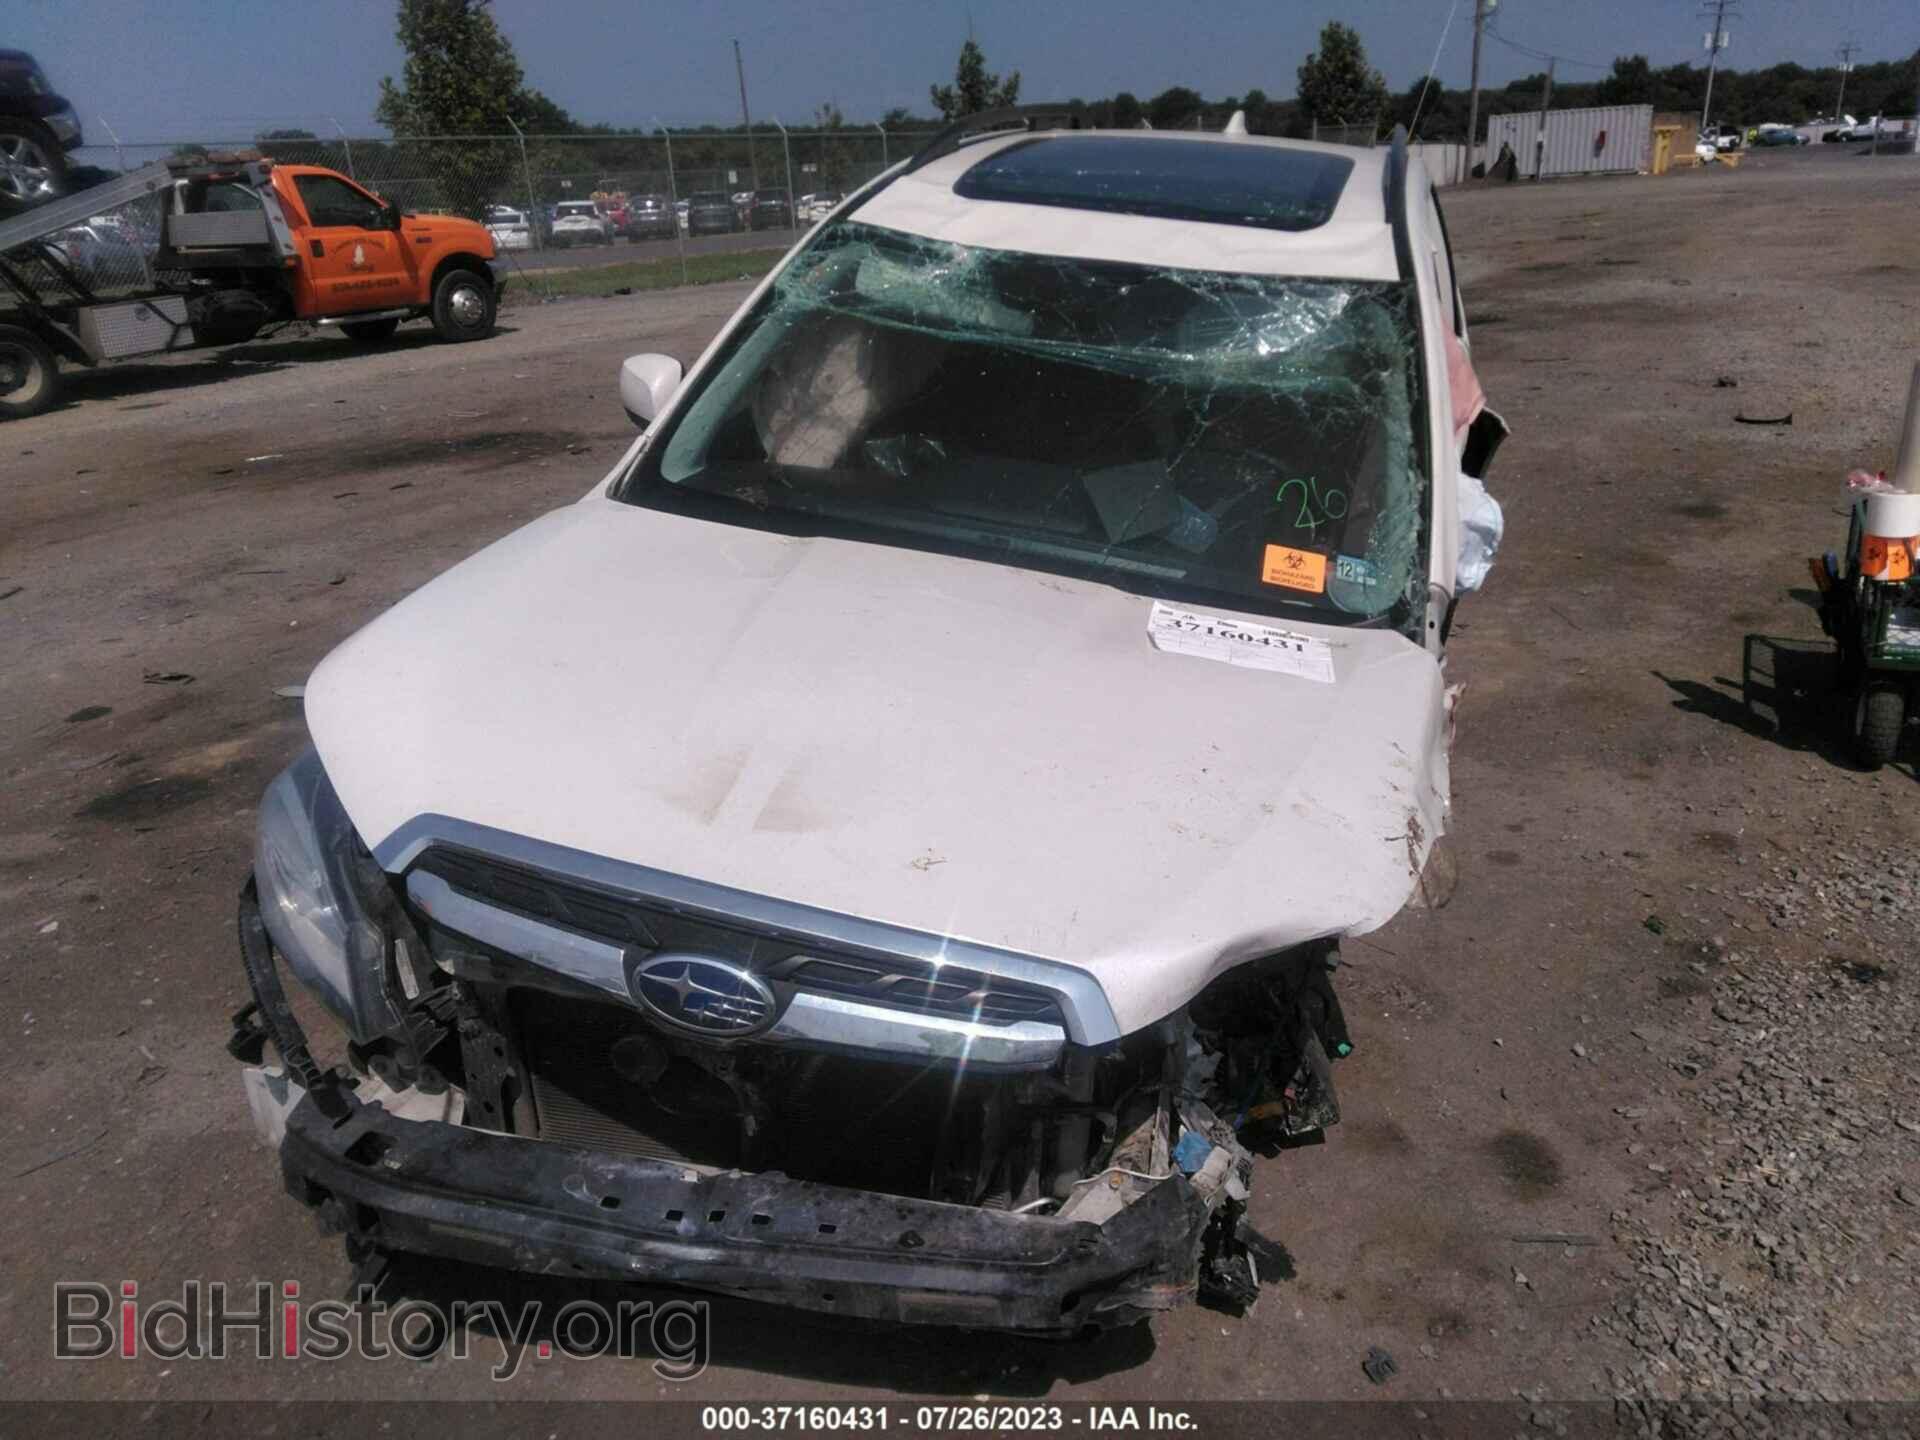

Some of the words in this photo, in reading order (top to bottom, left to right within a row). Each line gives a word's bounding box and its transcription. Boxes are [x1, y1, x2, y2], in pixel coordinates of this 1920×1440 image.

[1276, 476, 1349, 531] 26
[1339, 559, 1354, 578] 12
[1166, 618, 1304, 653] 37160431
